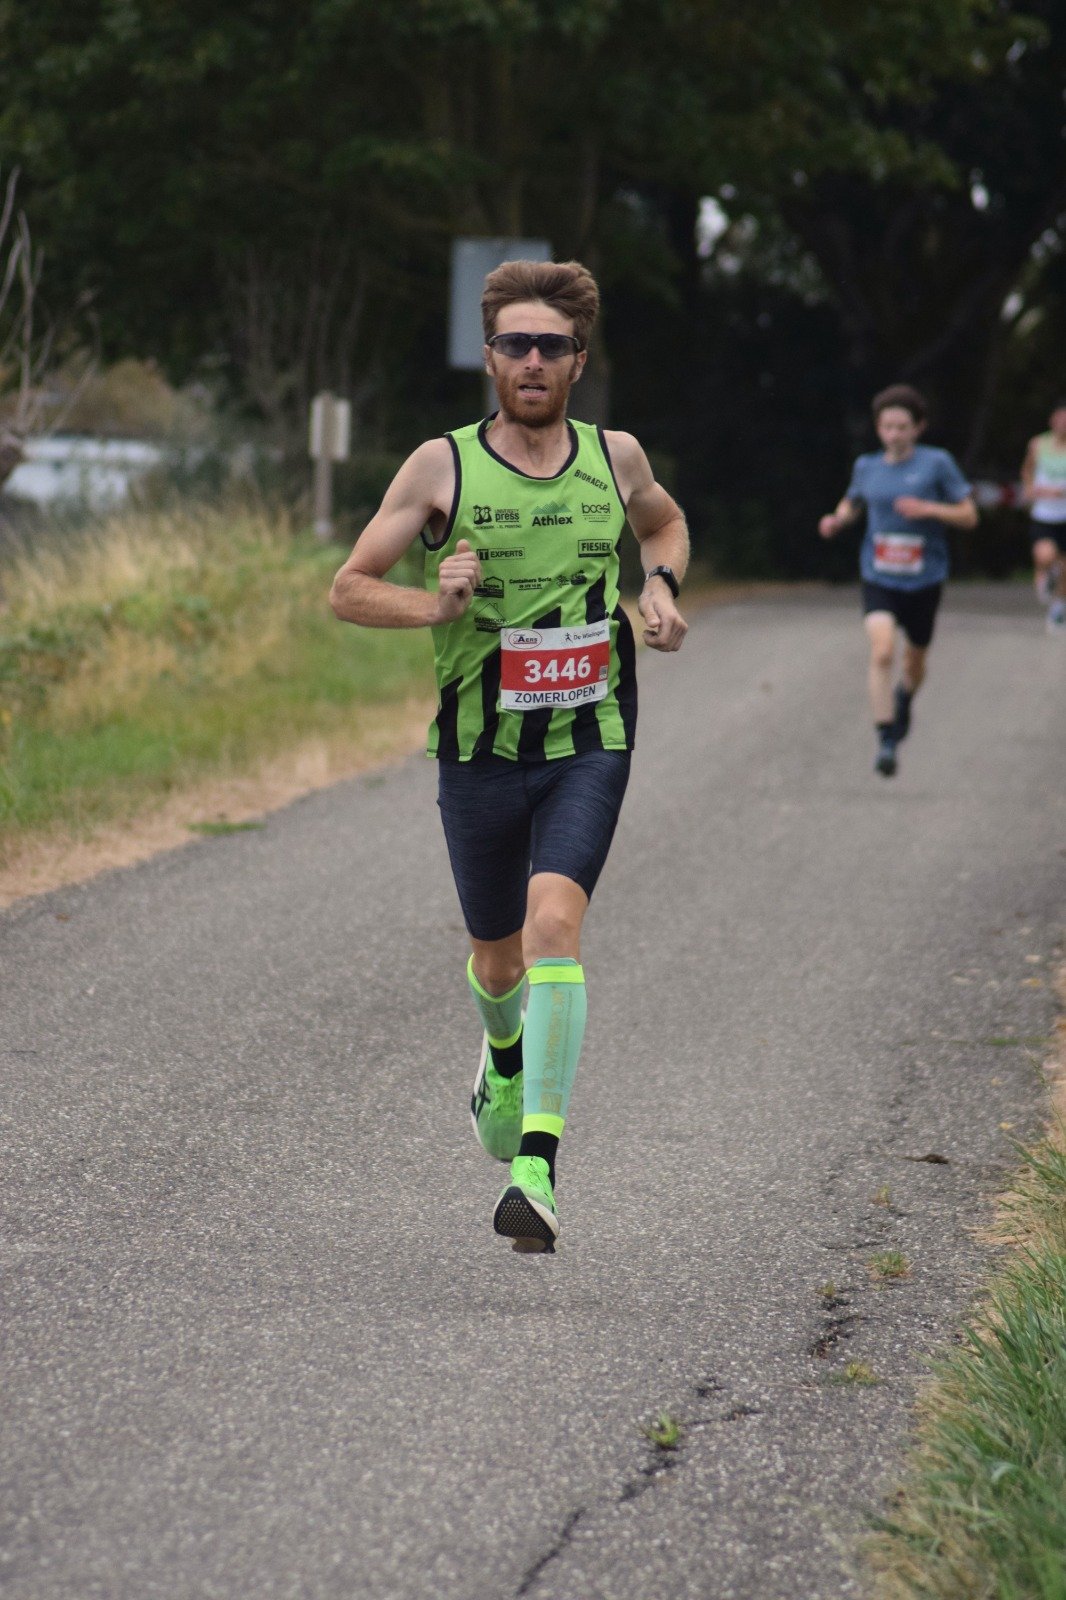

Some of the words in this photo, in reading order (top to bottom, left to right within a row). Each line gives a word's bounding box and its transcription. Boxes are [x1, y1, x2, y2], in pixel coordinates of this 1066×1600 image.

[574, 469, 608, 491] BIORACER
[495, 512, 520, 523] press
[532, 514, 573, 527] Athlex
[490, 550, 523, 558] EXPERTS
[524, 655, 591, 683] 3446
[514, 685, 596, 703] ZOMERLOPEN
